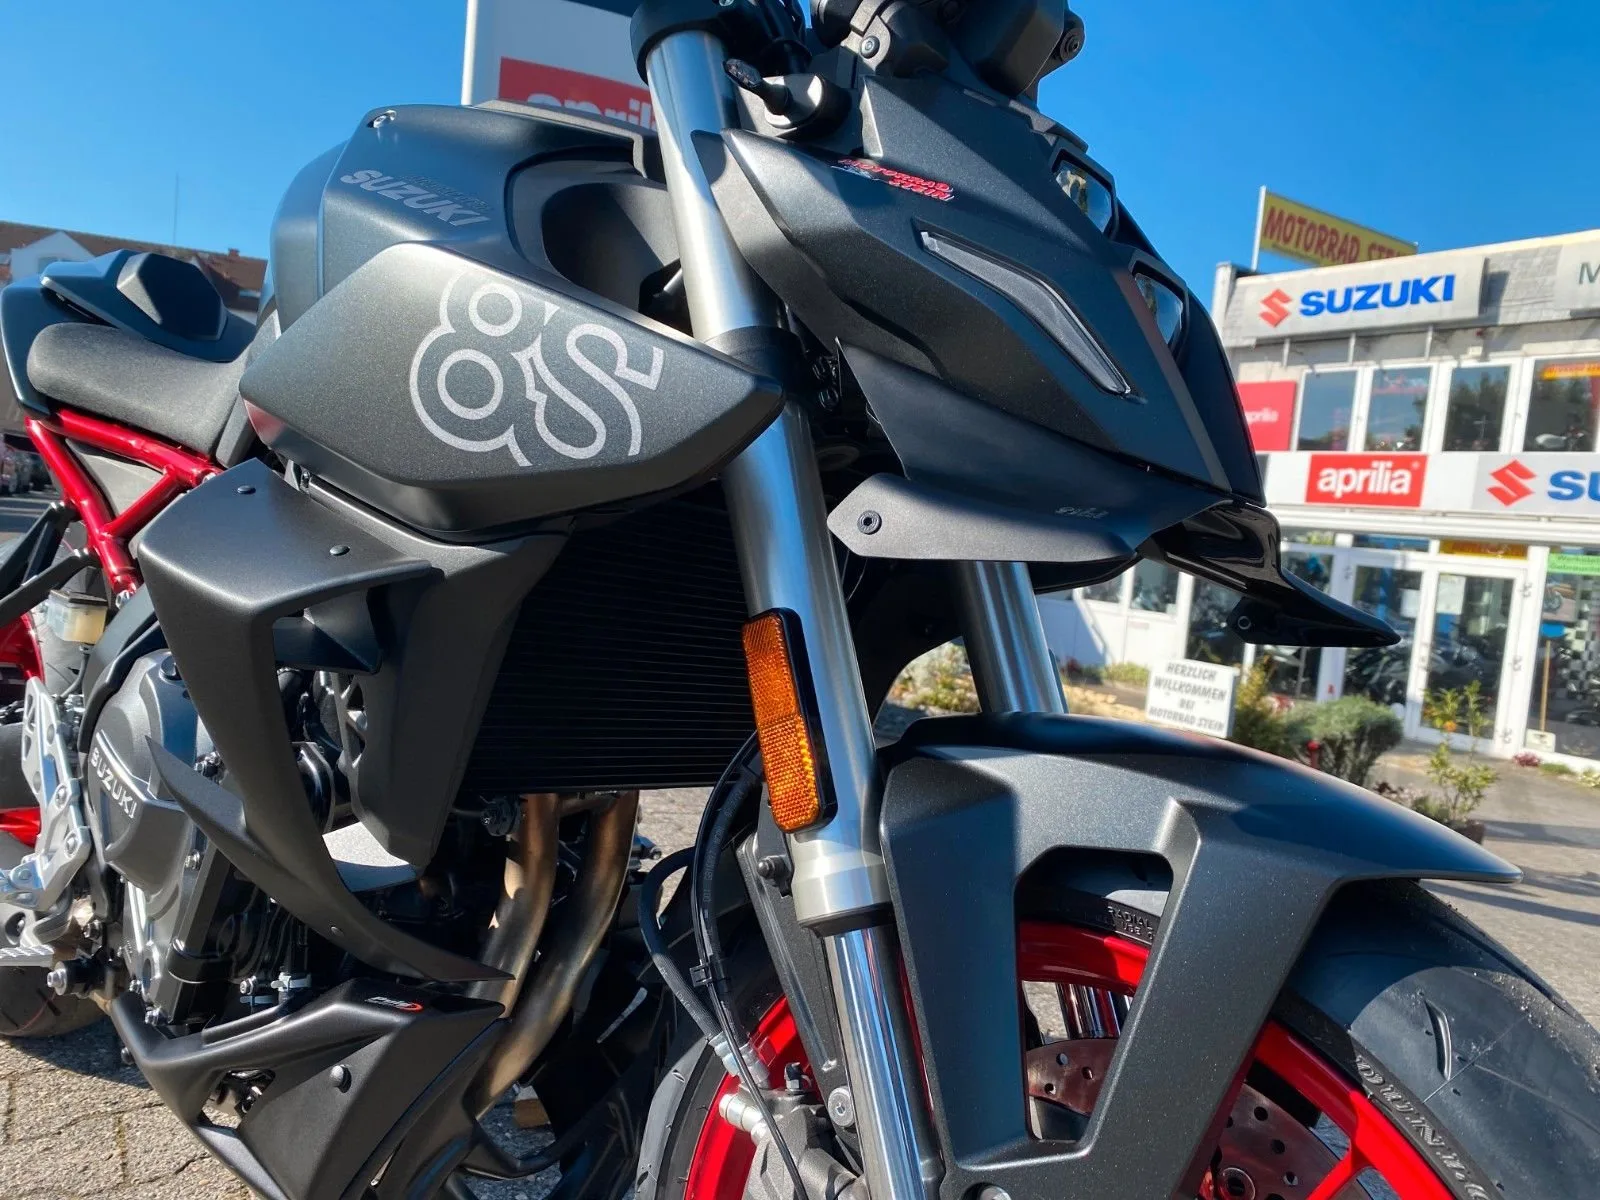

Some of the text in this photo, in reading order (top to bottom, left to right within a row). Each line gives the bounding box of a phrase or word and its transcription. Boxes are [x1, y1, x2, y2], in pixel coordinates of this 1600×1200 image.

[340, 169, 490, 227] SUZUKI
[1263, 206, 1361, 264] MOTORRAD
[1300, 274, 1457, 317] SUZUKI
[1317, 460, 1411, 499] aprilia
[1154, 675, 1228, 701] WILLKOMMEN
[1166, 662, 1218, 682] HERZLICH
[1149, 706, 1197, 725] MOTORRAD
[1178, 698, 1196, 710] BEI
[90, 747, 138, 819] SUZUKI
[1107, 905, 1153, 931] RADIAL
